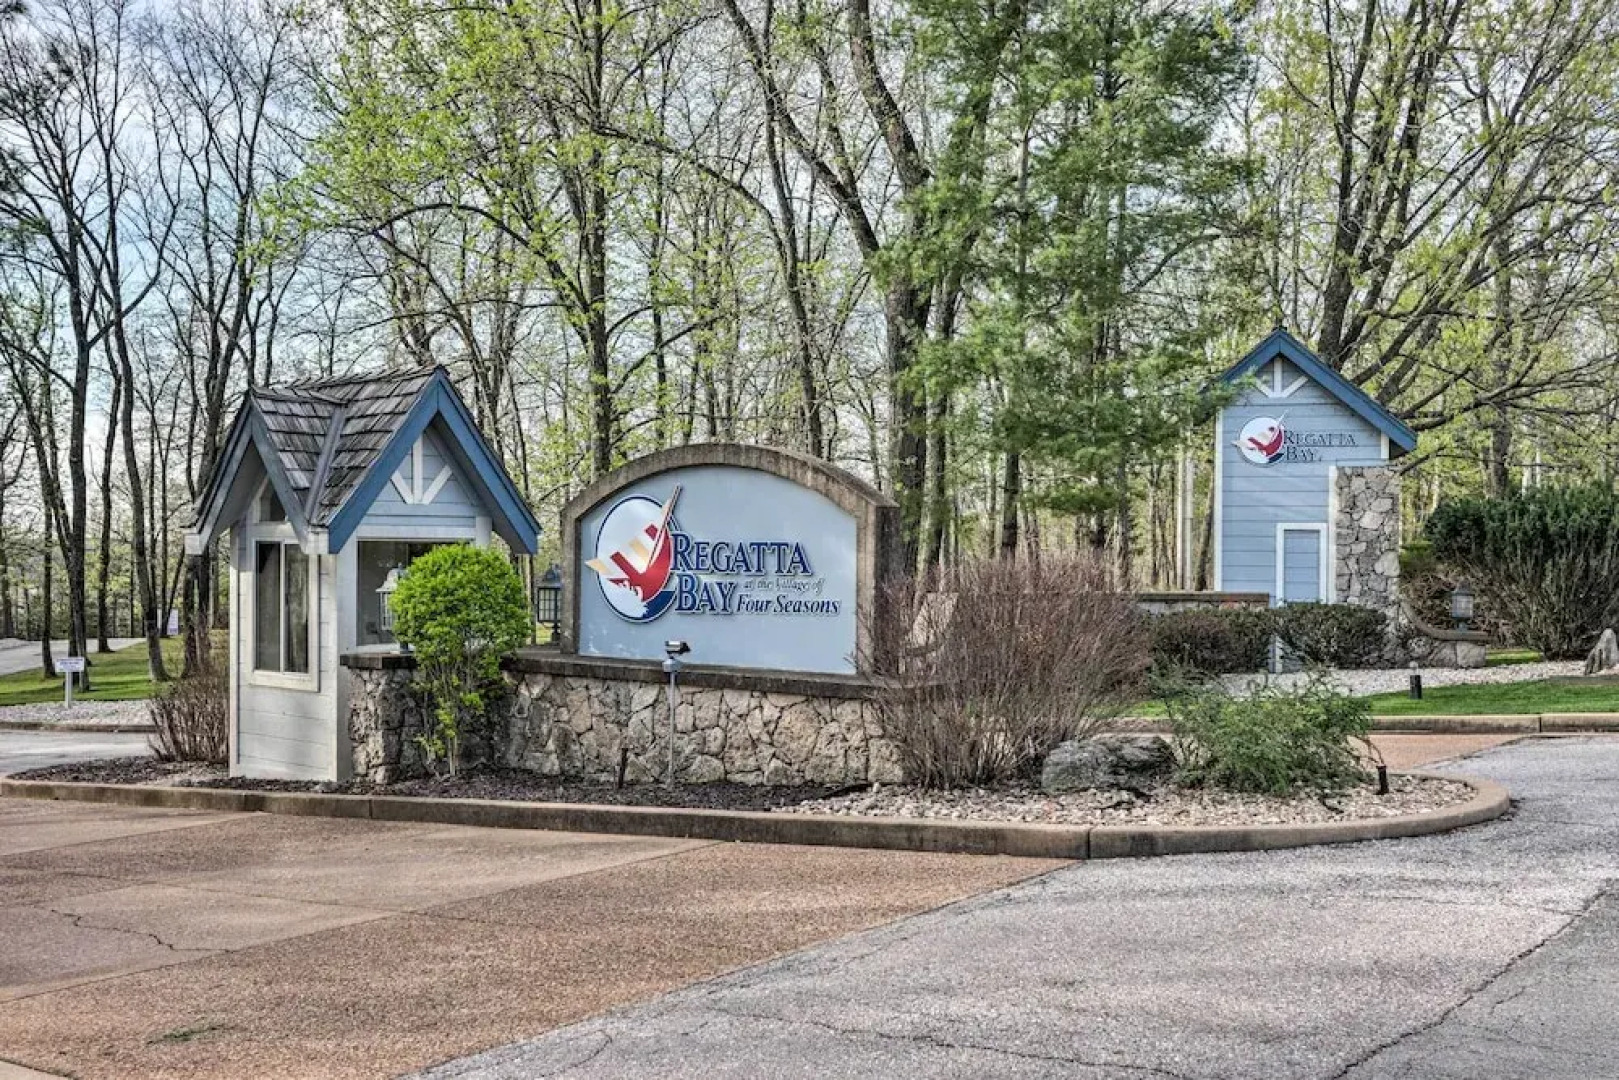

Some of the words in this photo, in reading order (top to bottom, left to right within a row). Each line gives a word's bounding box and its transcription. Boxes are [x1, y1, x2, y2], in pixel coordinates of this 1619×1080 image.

[1283, 430, 1356, 446] REGATTA
[1286, 446, 1318, 461] BAY
[670, 533, 811, 575] REGATTA
[674, 574, 735, 612] BAY
[744, 579, 754, 590] at
[757, 578, 773, 590] the
[812, 578, 825, 595] of
[736, 594, 772, 613] Four
[773, 594, 839, 614] Seasons
